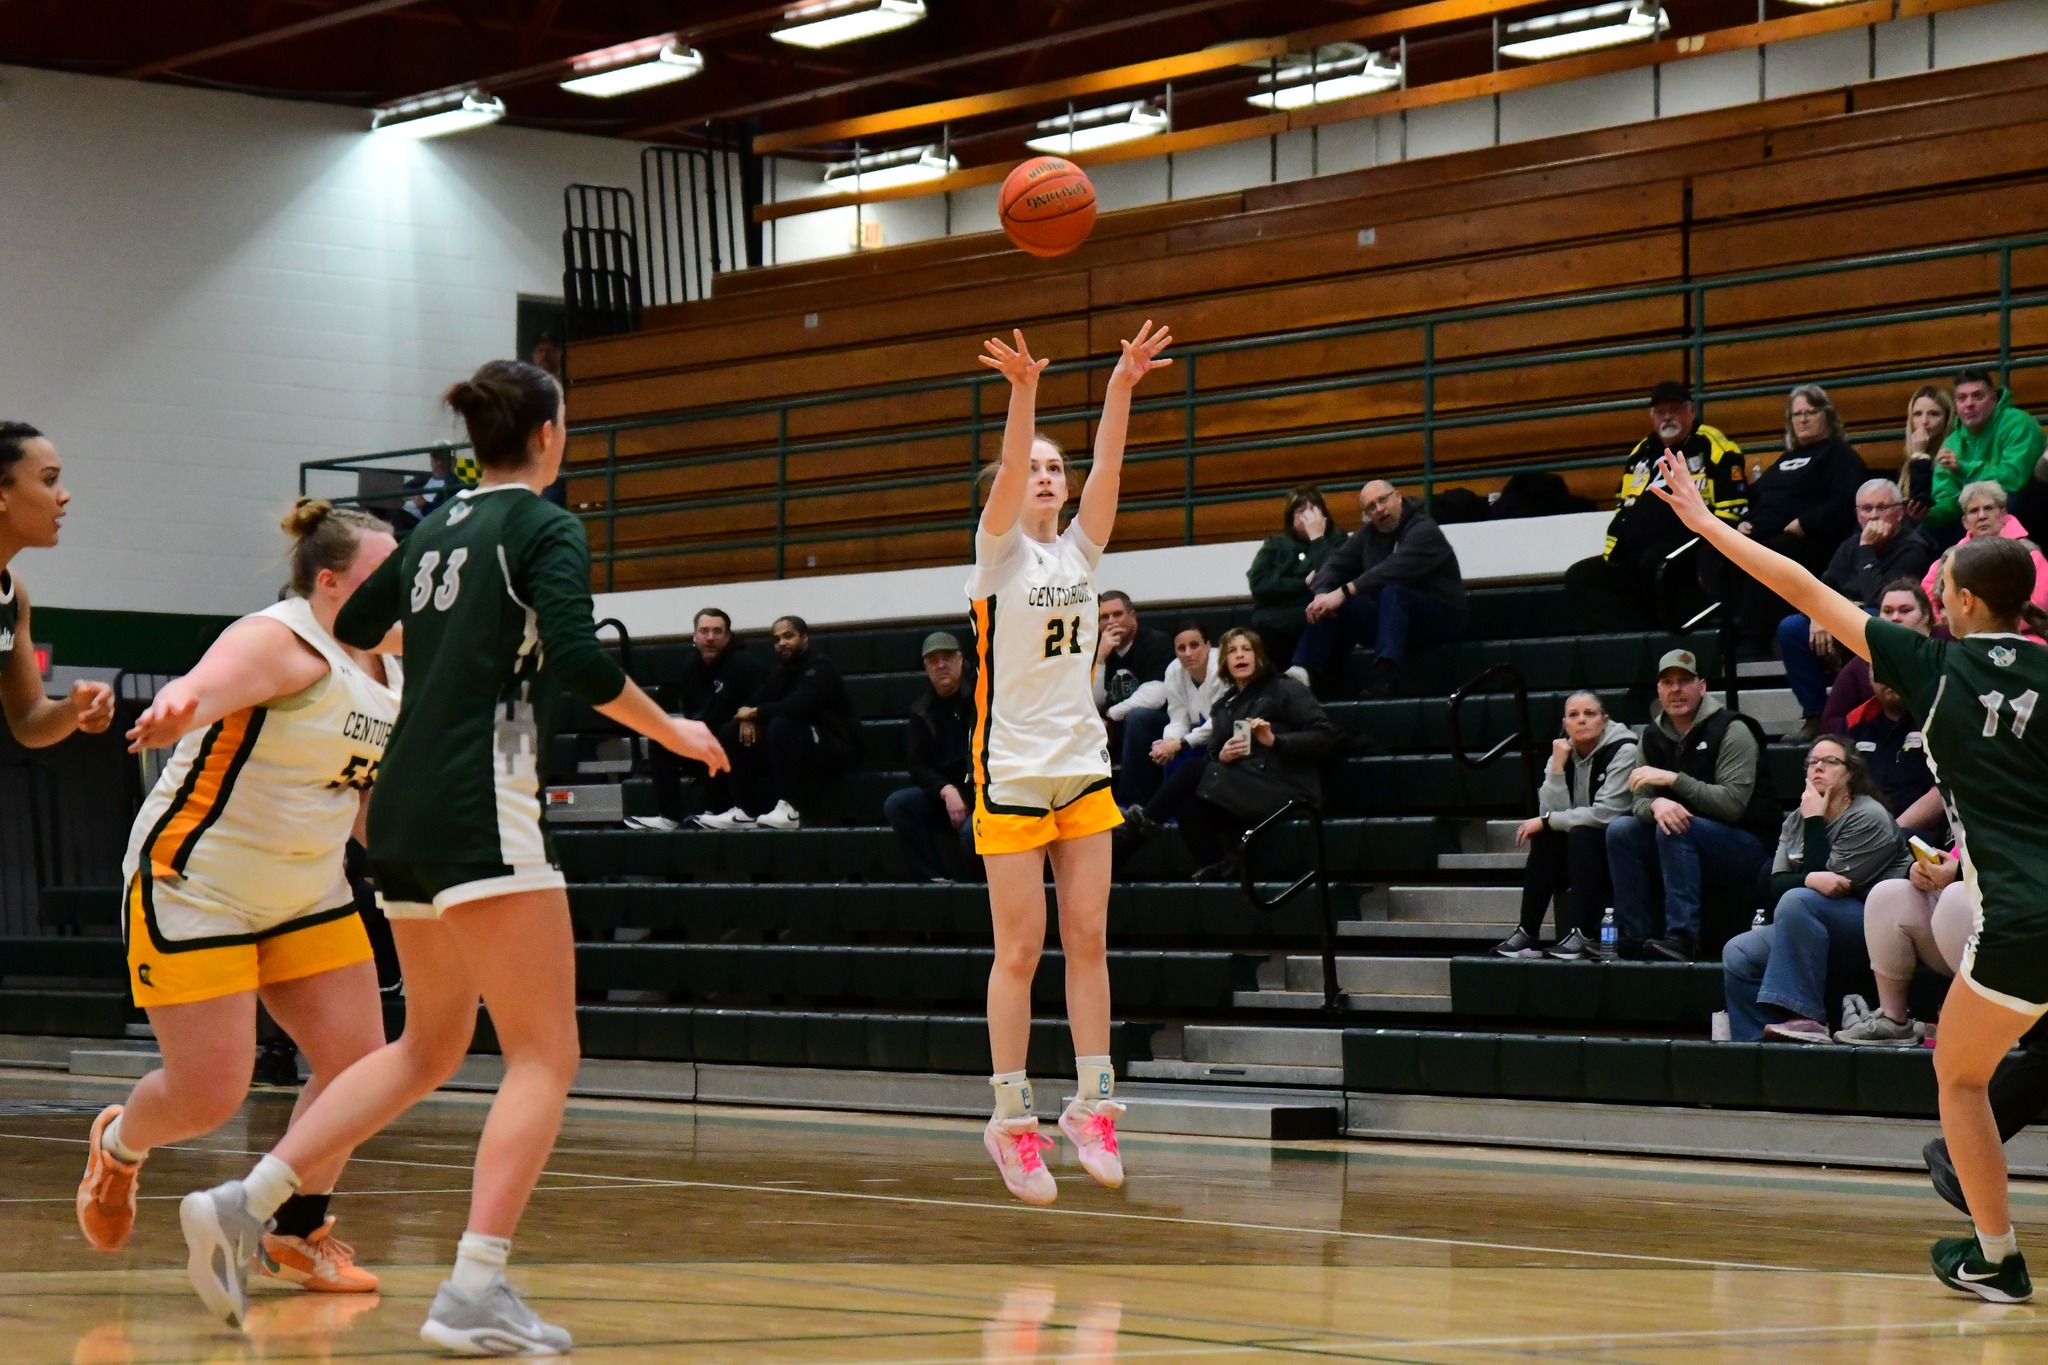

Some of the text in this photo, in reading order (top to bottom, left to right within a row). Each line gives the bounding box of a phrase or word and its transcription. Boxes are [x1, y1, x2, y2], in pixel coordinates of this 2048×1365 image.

[410, 547, 468, 613] 33
[1044, 614, 1082, 658] 21
[1978, 688, 2039, 739] 11
